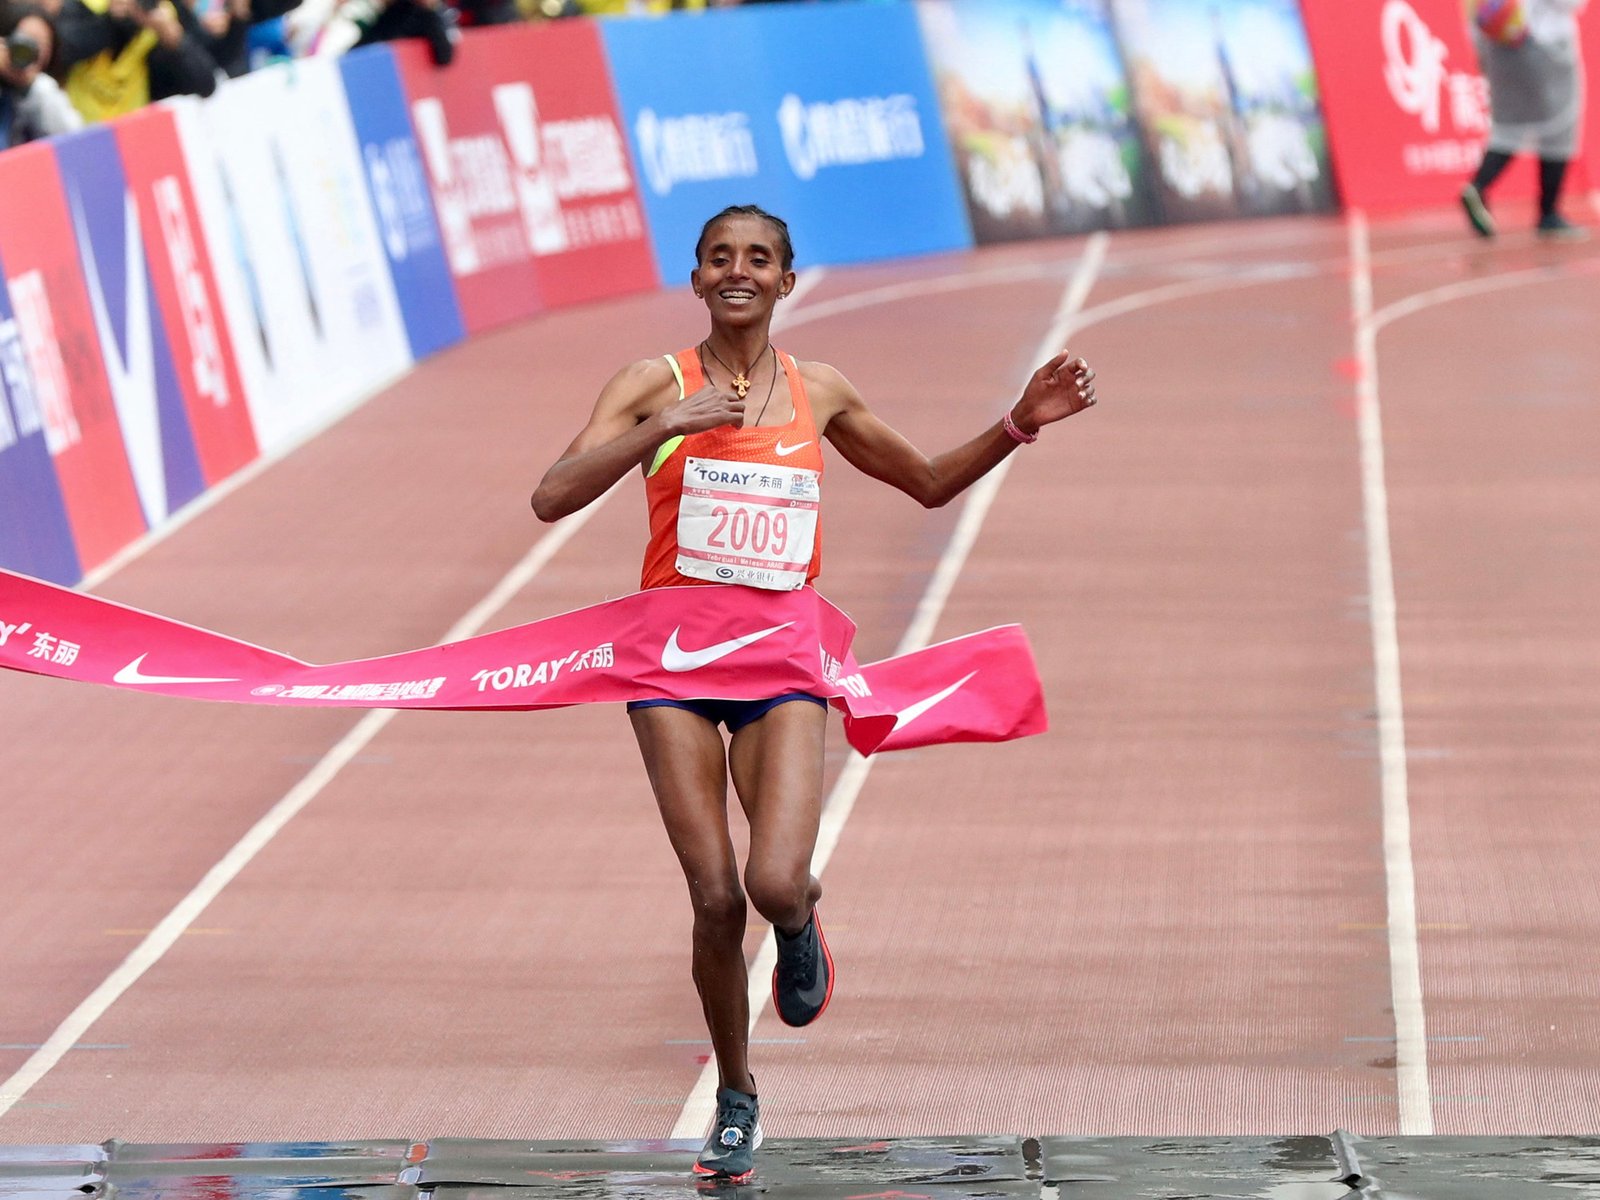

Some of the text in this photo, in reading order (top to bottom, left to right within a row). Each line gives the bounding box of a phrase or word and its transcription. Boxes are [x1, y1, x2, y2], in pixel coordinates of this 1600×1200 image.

[758, 475, 782, 489] 东丽
[707, 505, 788, 556] 2009
[26, 632, 81, 666] 东丽
[570, 642, 614, 673] 东丽
